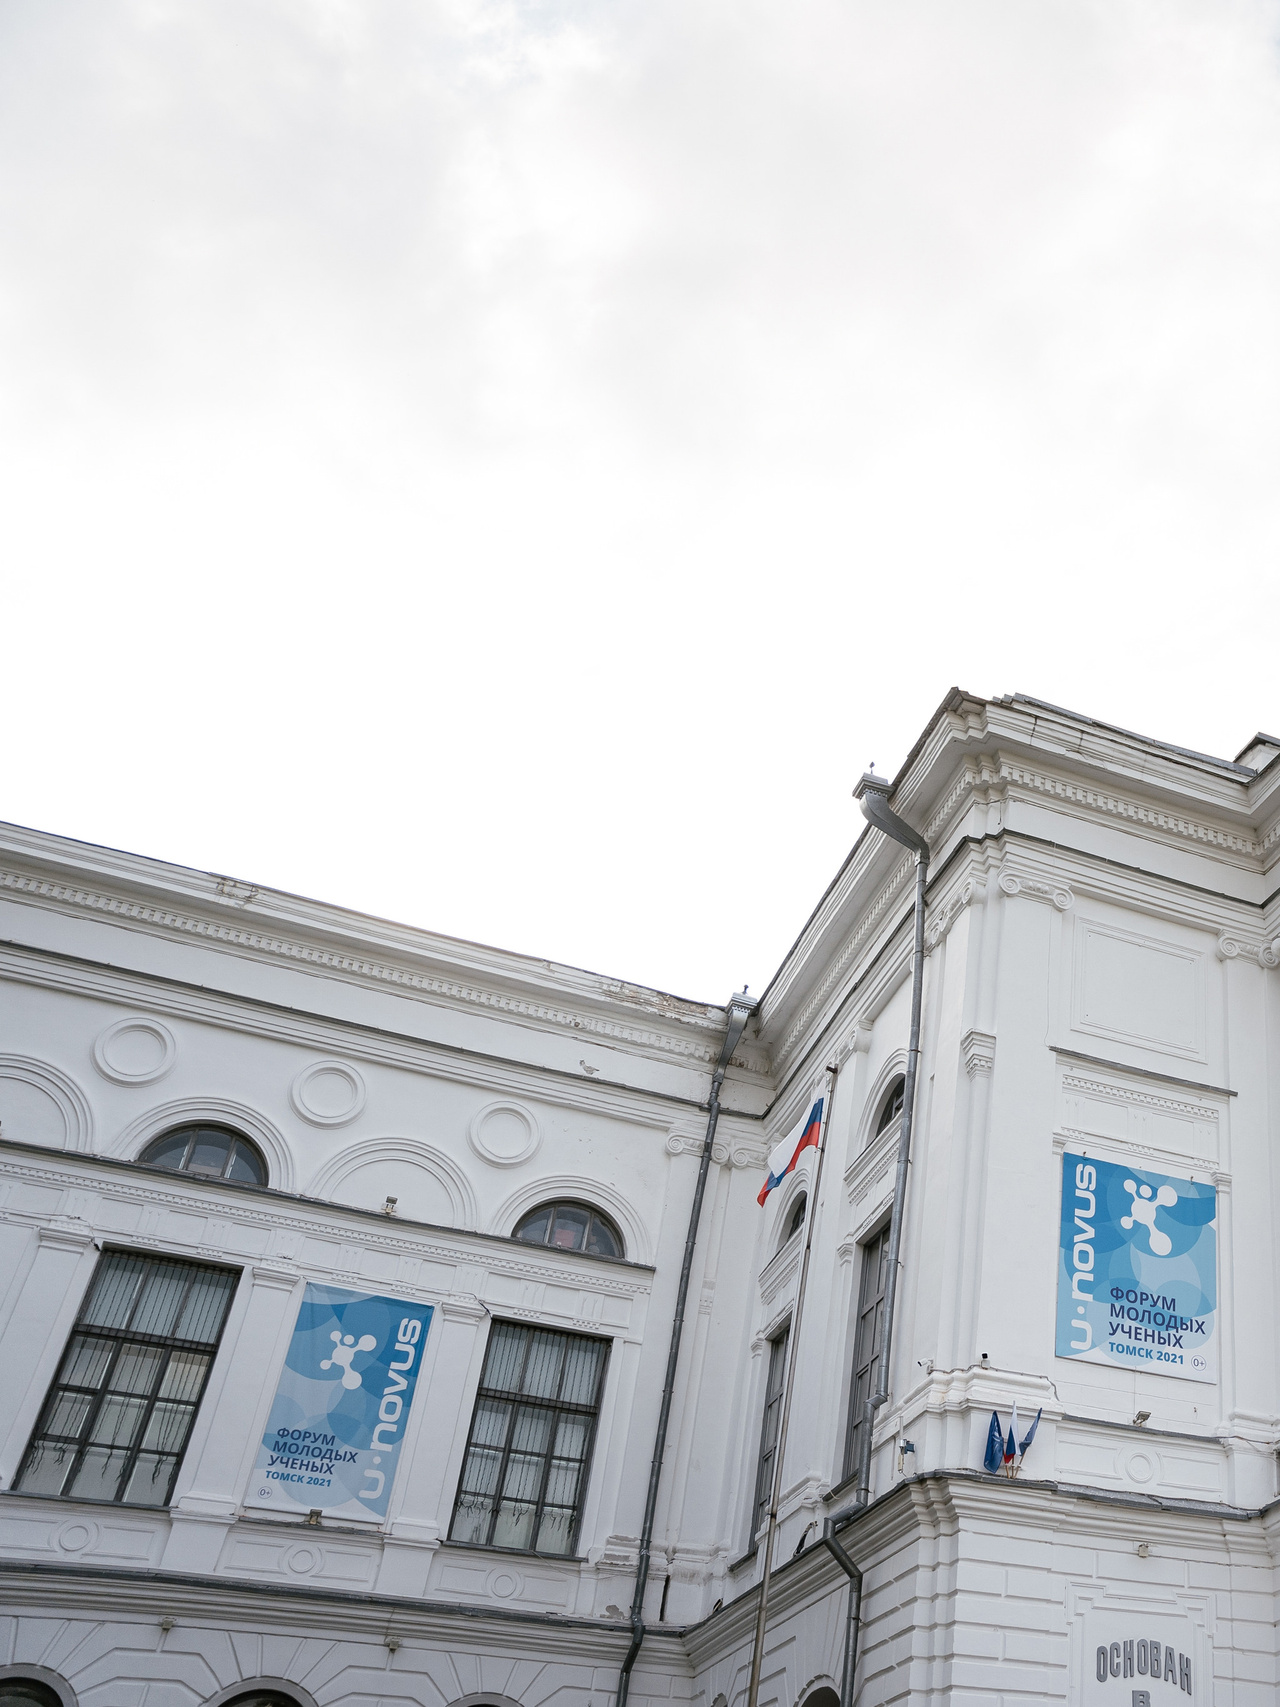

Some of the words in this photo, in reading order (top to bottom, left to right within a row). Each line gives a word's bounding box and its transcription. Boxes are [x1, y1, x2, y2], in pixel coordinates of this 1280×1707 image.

[1110, 1286, 1176, 1312] ФОРУМ
[1110, 1303, 1206, 1335] МОЛОДЫХ
[1108, 1321, 1184, 1349] УЧЕНЫХ
[1109, 1342, 1154, 1360] ТОМСК
[1156, 1350, 1184, 1365] 2021
[1192, 1357, 1205, 1368] 0+
[276, 1427, 336, 1447] ФОРУМ
[272, 1440, 359, 1464] МОЛОДЫХ
[267, 1454, 336, 1475] УЧЕНЫХ
[265, 1470, 305, 1484] ТОМСК
[306, 1475, 332, 1488] 2021
[259, 1487, 271, 1498] 0+
[1096, 1638, 1192, 1696] ОСНОВАН
